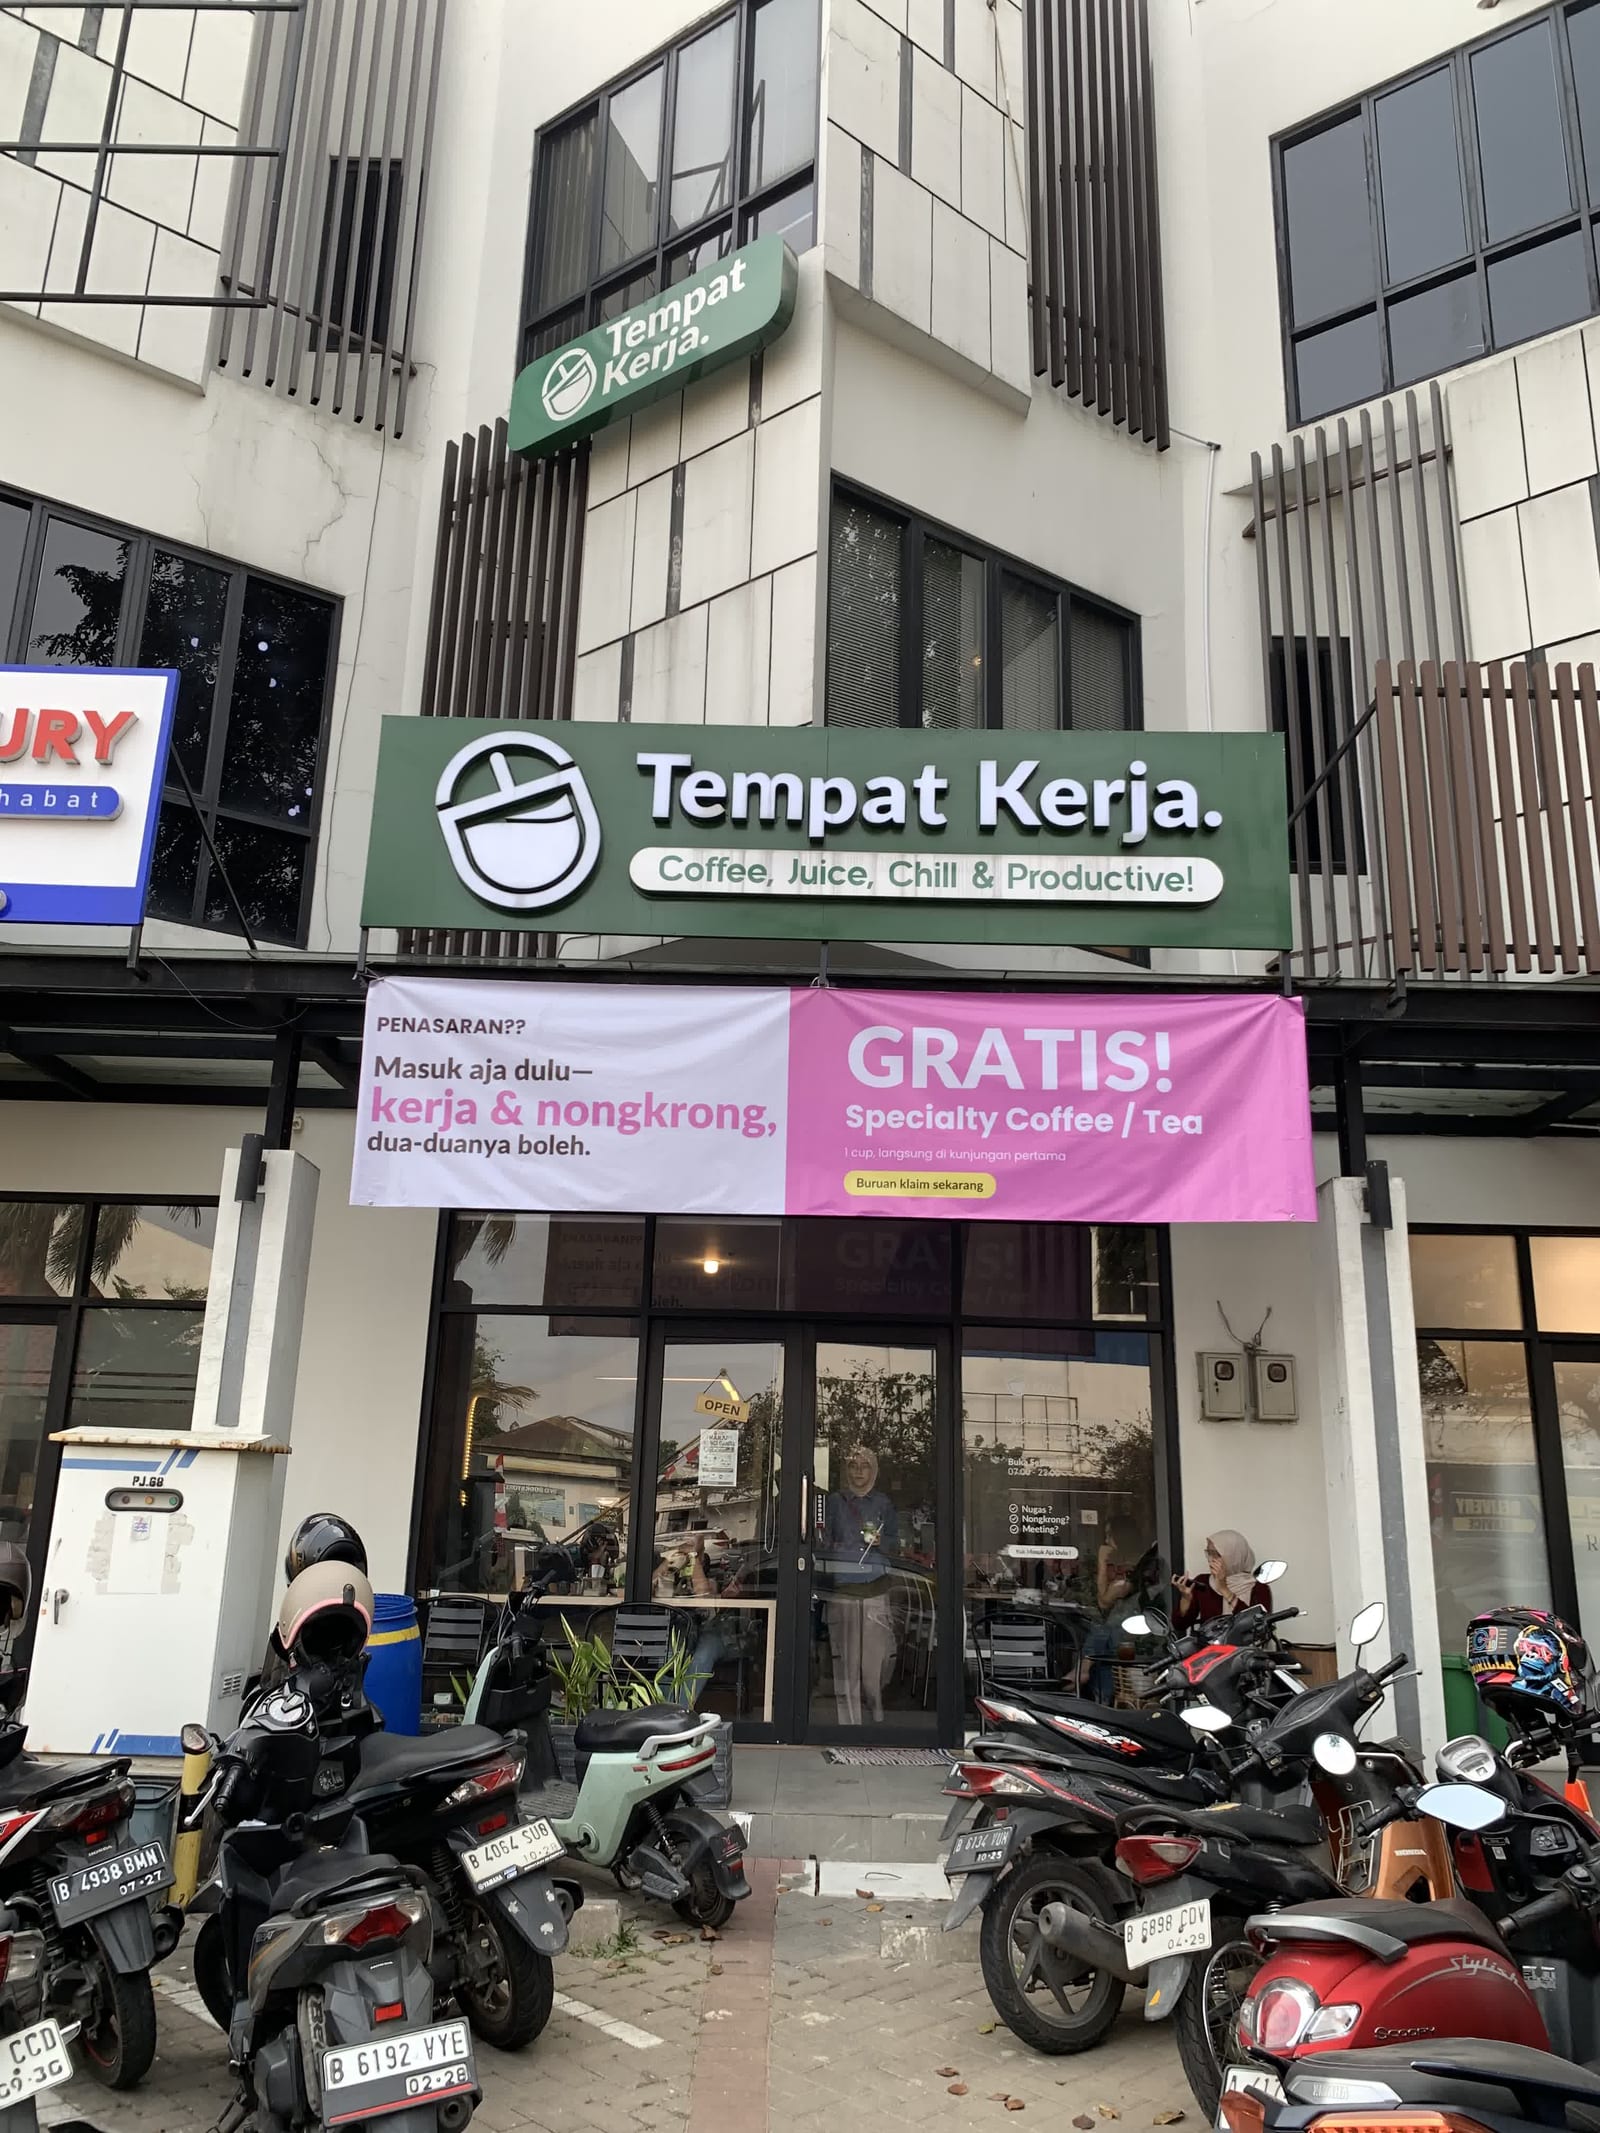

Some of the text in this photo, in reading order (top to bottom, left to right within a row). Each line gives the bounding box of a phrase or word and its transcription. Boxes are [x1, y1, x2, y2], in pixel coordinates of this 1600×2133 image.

[606, 258, 746, 357] Tempat
[602, 326, 709, 396] Kerja.
[637, 753, 1222, 844] Tempat Kerja.
[658, 855, 1193, 892] Coffee, Juice, Chill & Productive!
[377, 1017, 526, 1034] PENASARAN??
[374, 1056, 463, 1080] Masuk
[469, 1058, 507, 1085] aja
[847, 1025, 1173, 1093] GRATIS!
[371, 1086, 777, 1138] kerja & nongkrong,
[845, 1102, 1204, 1139] Specialty Coffee / Tea
[367, 1131, 591, 1158] dua-duanya boleh.
[851, 1149, 875, 1161] cup,
[878, 1148, 932, 1161] langsung
[936, 1149, 947, 1159] di
[950, 1149, 1012, 1162] kunjungan
[1014, 1152, 1067, 1163] pertama
[856, 1177, 984, 1192] Buruan klaim sekarang
[704, 1400, 740, 1416] OPEN
[1022, 1506, 1046, 1514] Nugas
[1022, 1515, 1070, 1525] Nongkrong?
[1022, 1525, 1059, 1534] Meeting?
[59, 1882, 70, 1901] B
[81, 1863, 123, 1891] 4938
[124, 1848, 158, 1875] BMN
[468, 1854, 480, 1869] B
[1126, 1905, 1205, 1943] B 6898 CDV
[1449, 1954, 1520, 1988] Stylish
[9, 2027, 57, 2065] CCD
[329, 2030, 465, 2084] B 6192 VYE
